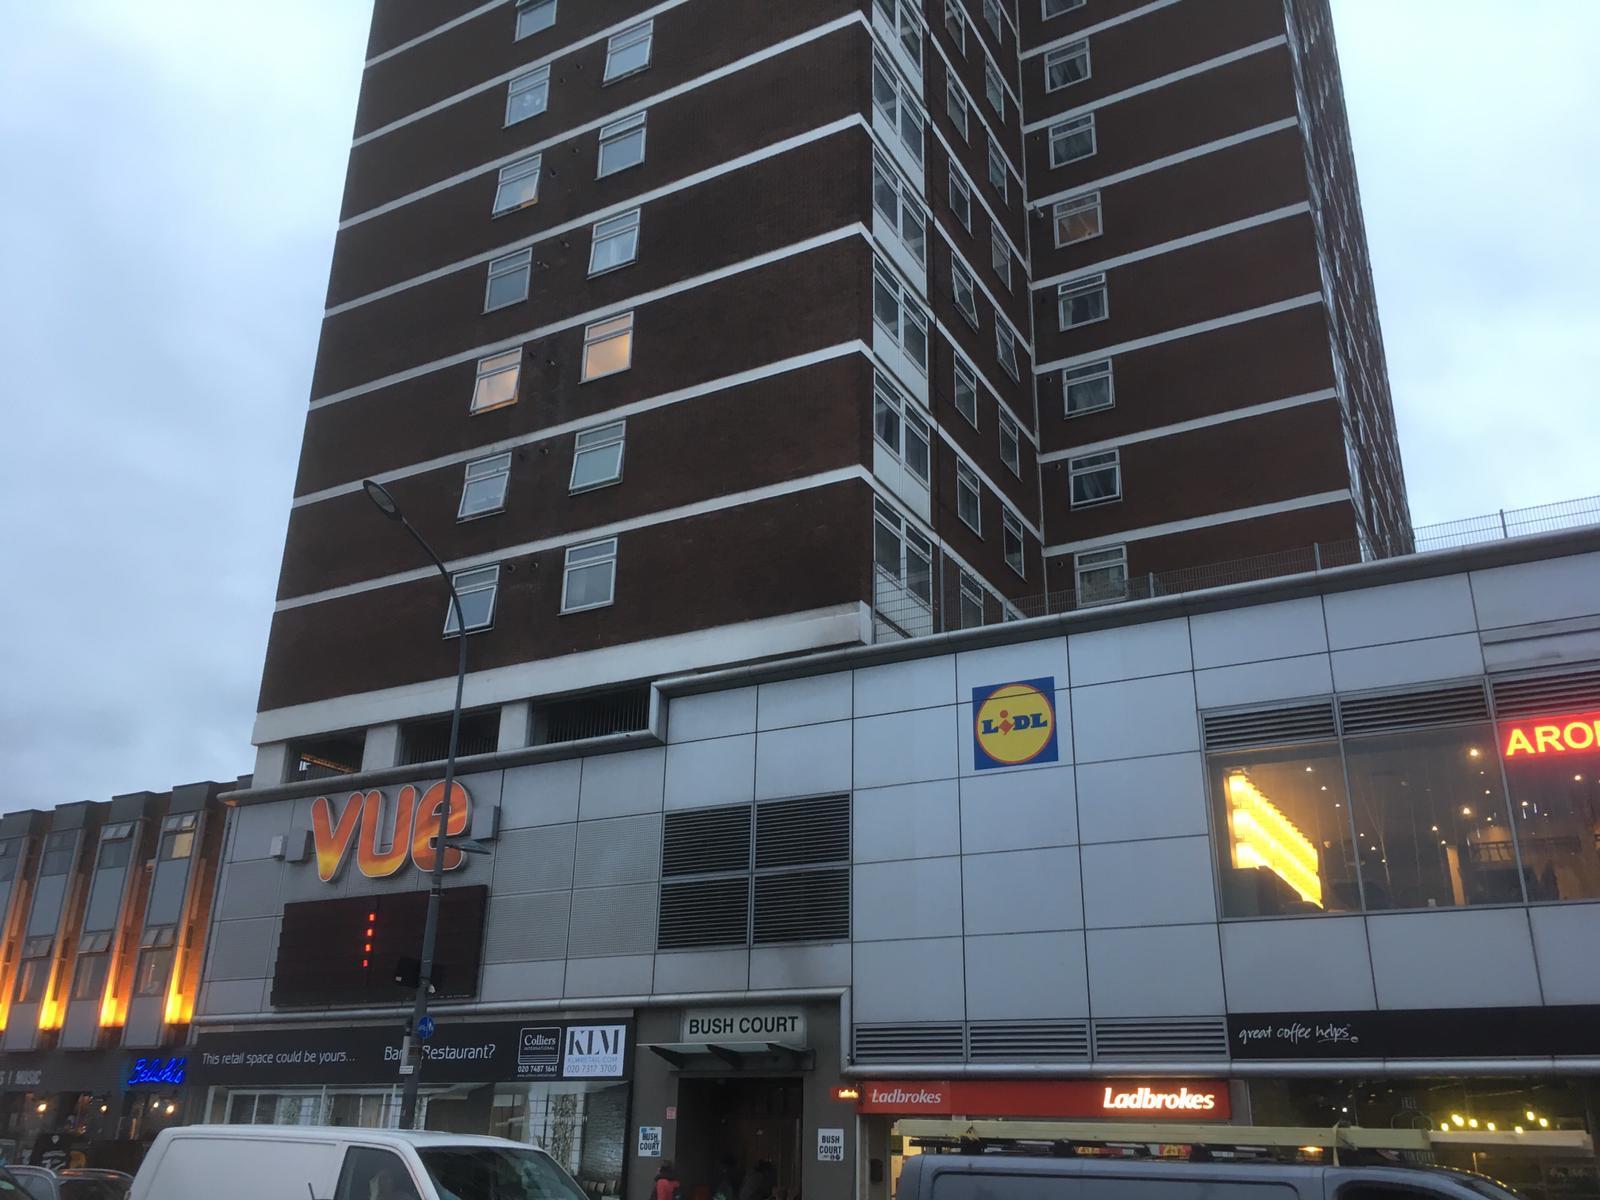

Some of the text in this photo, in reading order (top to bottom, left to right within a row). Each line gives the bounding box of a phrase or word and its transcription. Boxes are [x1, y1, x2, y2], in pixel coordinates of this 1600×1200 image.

[689, 1016, 799, 1034] BUSH COURT
[524, 1035, 556, 1046] Colliers
[568, 1029, 619, 1055] KLM
[1239, 1023, 1349, 1045] great coffee helps
[202, 1051, 355, 1067] This retail space could be yours...
[422, 1044, 496, 1061] Restaurant?
[566, 1065, 579, 1073] 020
[871, 1088, 942, 1105] Ladbrokes
[1103, 1087, 1215, 1111] Ladbrokes
[642, 1133, 658, 1141] BUSH
[821, 1135, 840, 1143] BUSH
[640, 1142, 660, 1151] COURT
[819, 1146, 842, 1154] COURT
